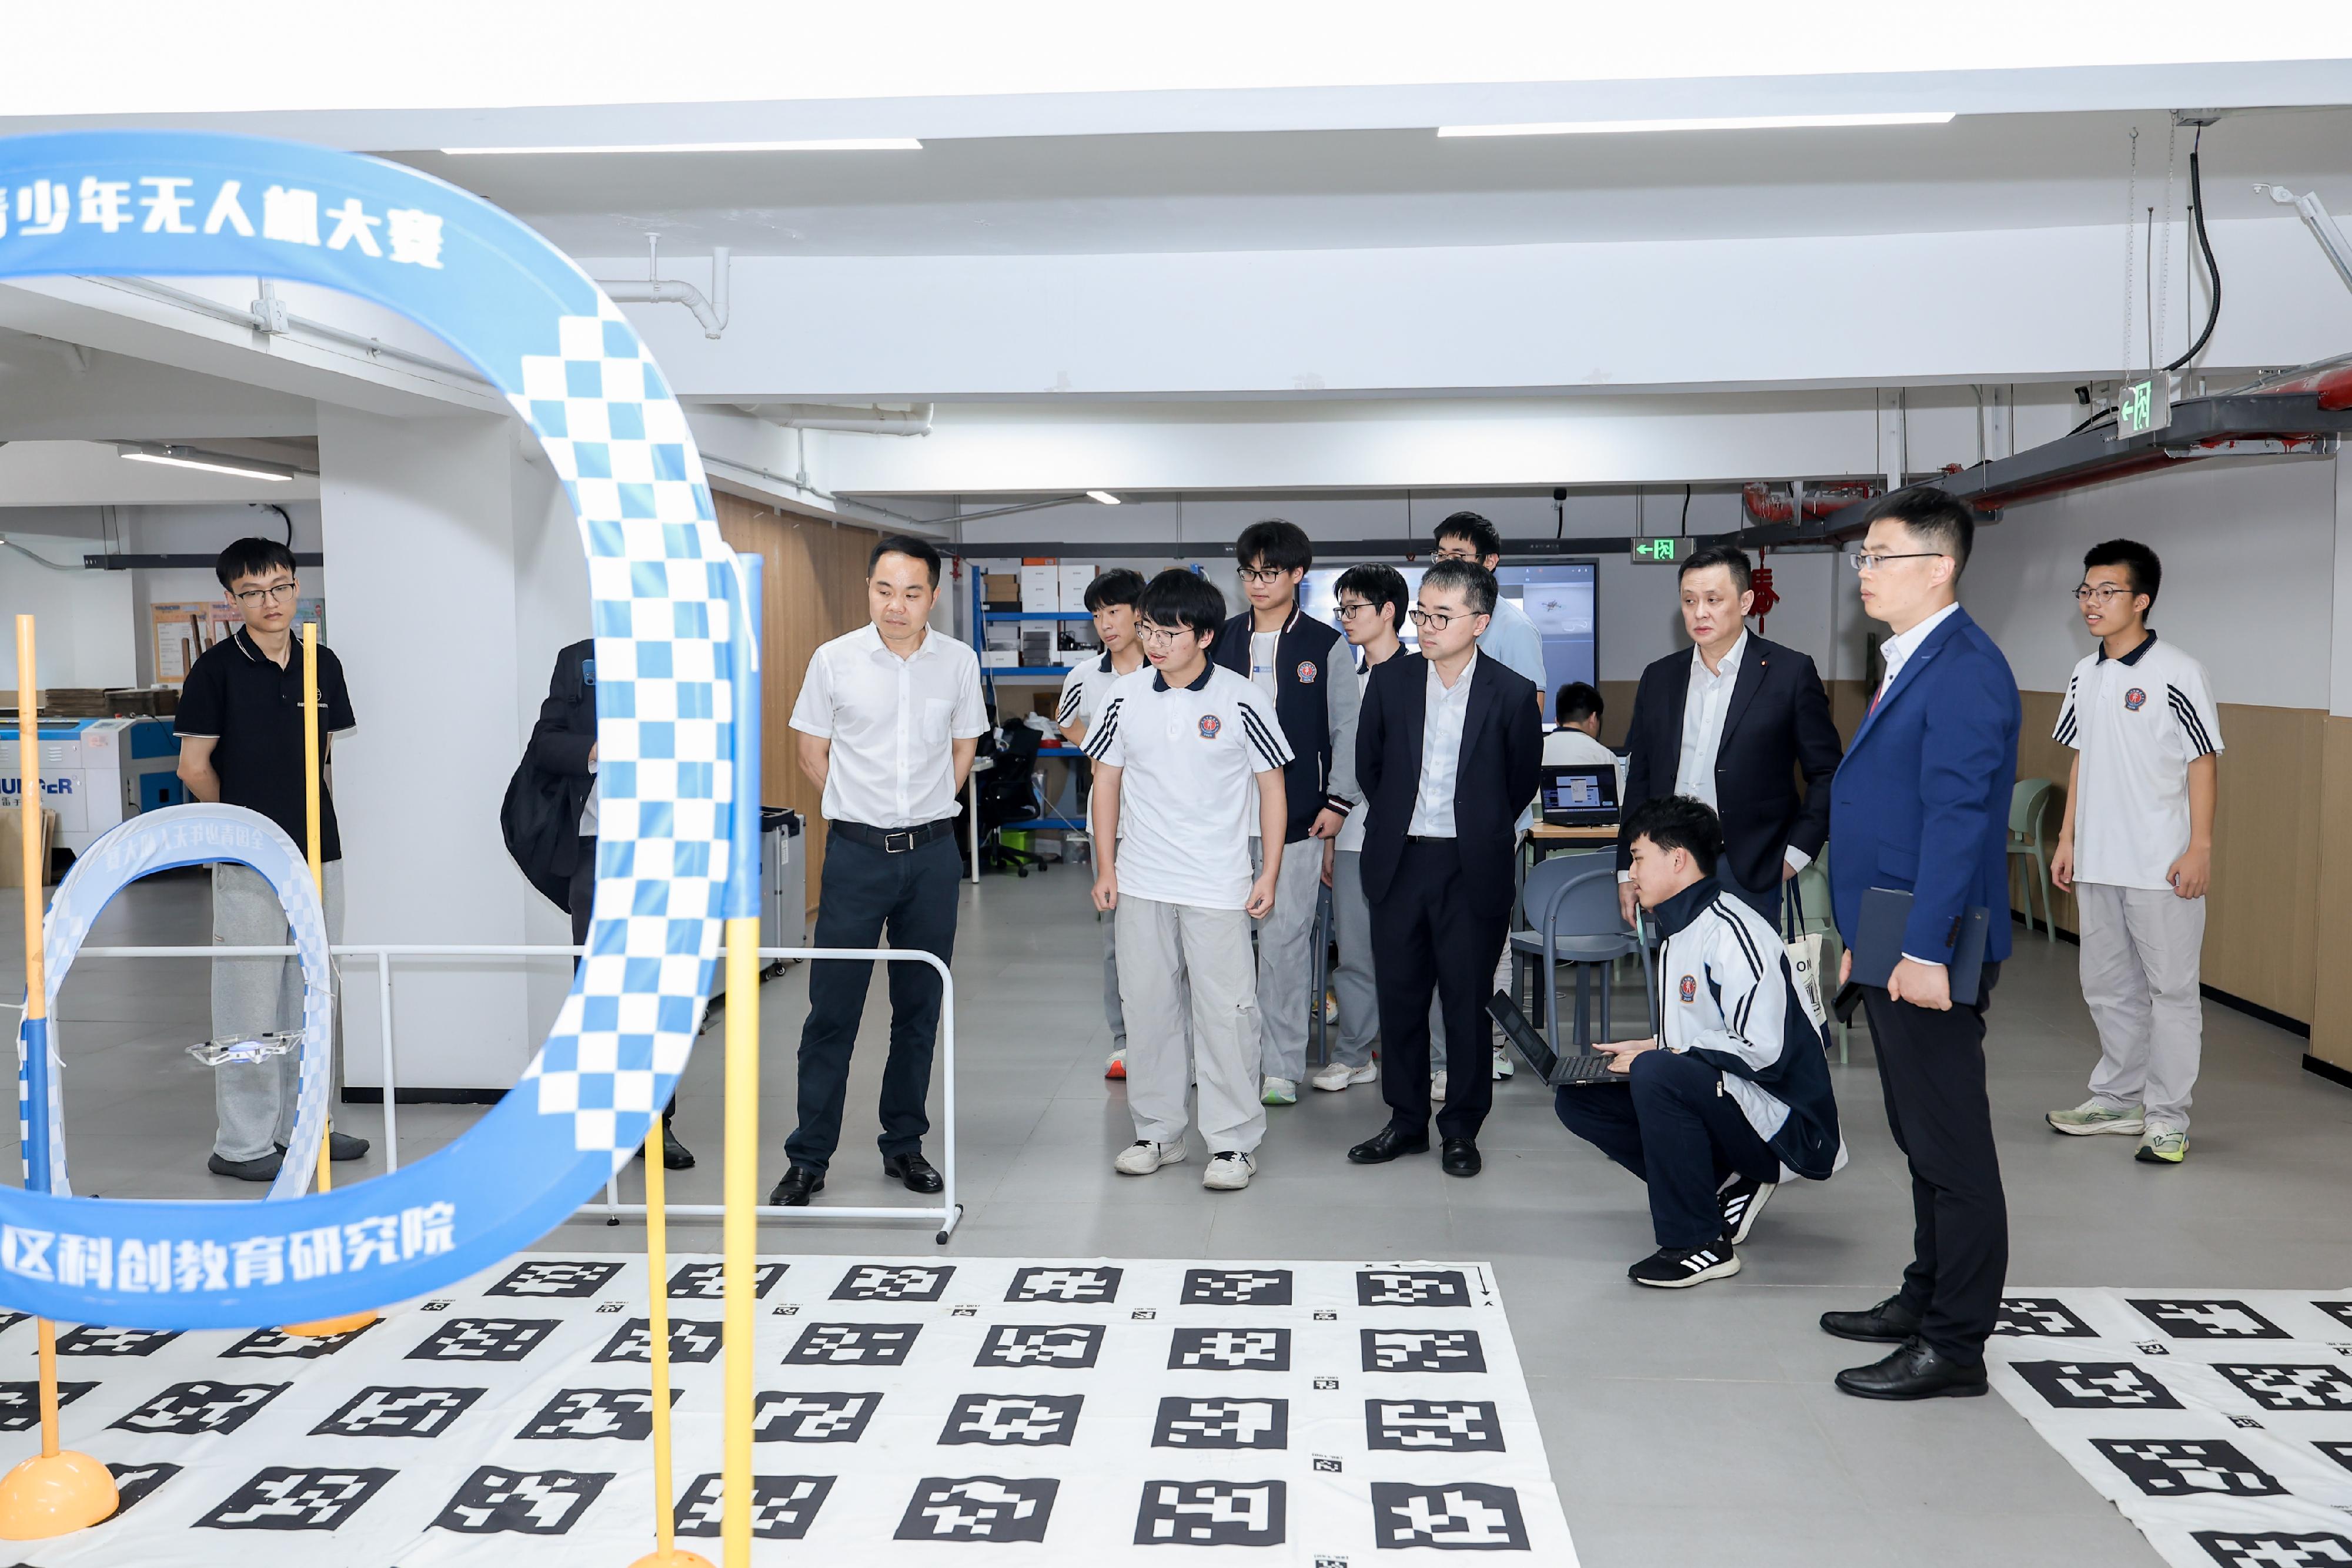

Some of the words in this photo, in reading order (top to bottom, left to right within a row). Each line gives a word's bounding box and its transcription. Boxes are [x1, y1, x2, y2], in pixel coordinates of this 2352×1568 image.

[0, 175, 445, 269] 少年无人机大赛
[1, 1201, 456, 1293] 区科创教育研究院
